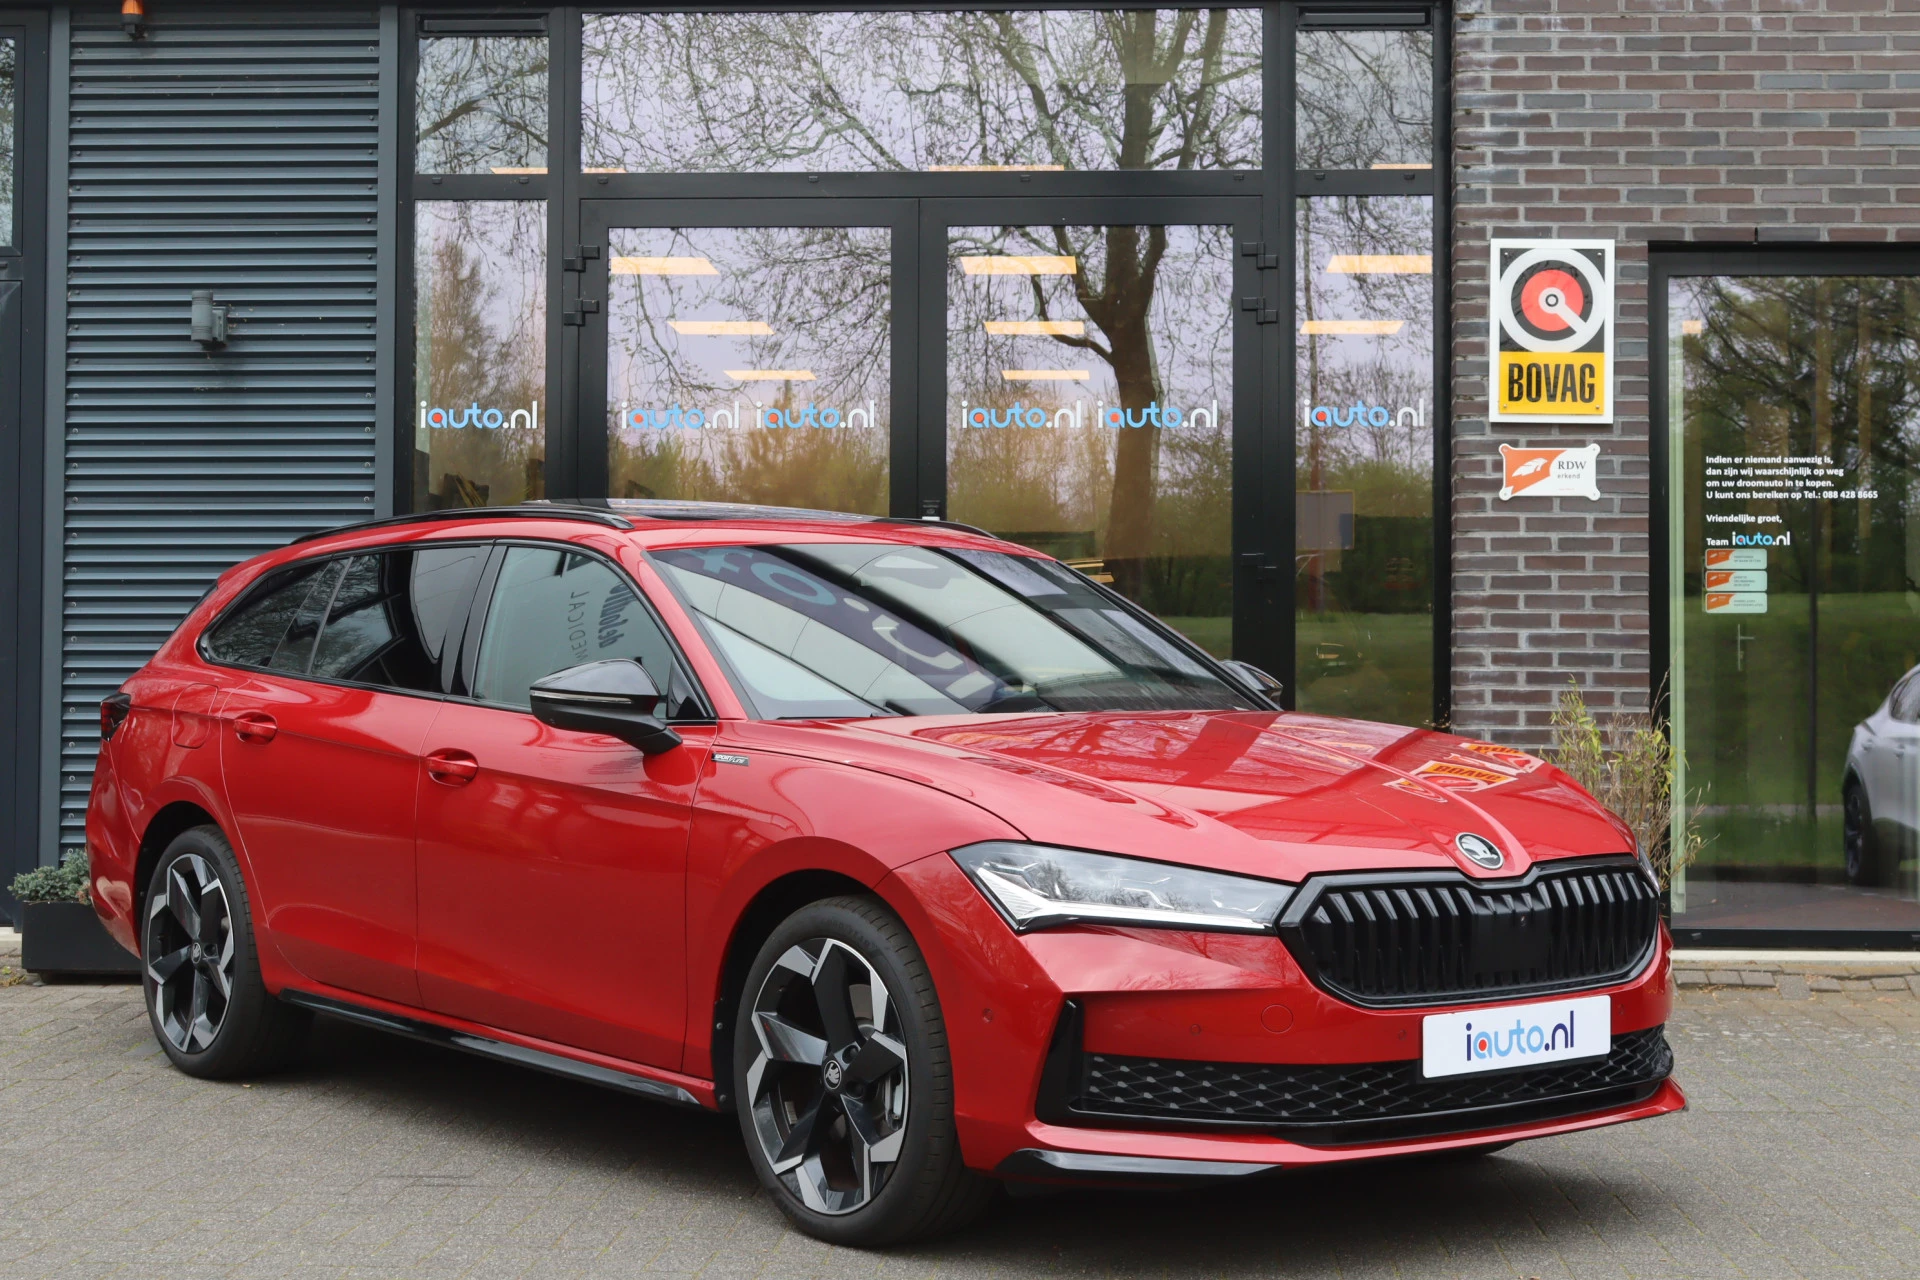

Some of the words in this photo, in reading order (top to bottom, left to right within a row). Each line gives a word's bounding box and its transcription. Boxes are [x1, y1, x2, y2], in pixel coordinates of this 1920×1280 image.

[1508, 363, 1595, 403] BOVAG
[420, 400, 538, 429] iauto.nl
[621, 400, 740, 429] iauto.nl
[756, 400, 875, 429] iauto.nl
[961, 400, 1081, 428] iauto.nl
[1097, 400, 1217, 428] iauto.nl
[1304, 398, 1425, 427] iauto.nl
[1557, 460, 1587, 470] RDW
[1706, 456, 1733, 464] Indien
[1745, 456, 1782, 464] niemand
[1784, 456, 1823, 466] aanwezig
[1824, 456, 1834, 465] is,
[1706, 467, 1722, 476] dan
[1724, 468, 1739, 477] zijn
[1740, 468, 1754, 477] wij
[1755, 467, 1812, 477] waarschijnlijk
[1814, 468, 1825, 477] op
[1826, 468, 1844, 477] weg
[1706, 491, 1713, 499] U
[1715, 491, 1734, 499] kunt
[1753, 491, 1790, 499] bereiken
[1791, 492, 1802, 500] op
[1804, 491, 1821, 499] Tel.:
[1823, 491, 1839, 499] 088
[1840, 491, 1856, 499] 428
[1858, 490, 1879, 499] 8665
[1737, 479, 1784, 487] droomauto
[1785, 479, 1794, 487] in
[1806, 479, 1835, 488] kopen.
[1706, 514, 1756, 524] Vriendelijke
[1758, 515, 1783, 524] groet,
[1706, 537, 1729, 546] Team
[1732, 531, 1791, 546] iauto.nl
[1465, 1010, 1575, 1062] iauto.nl
